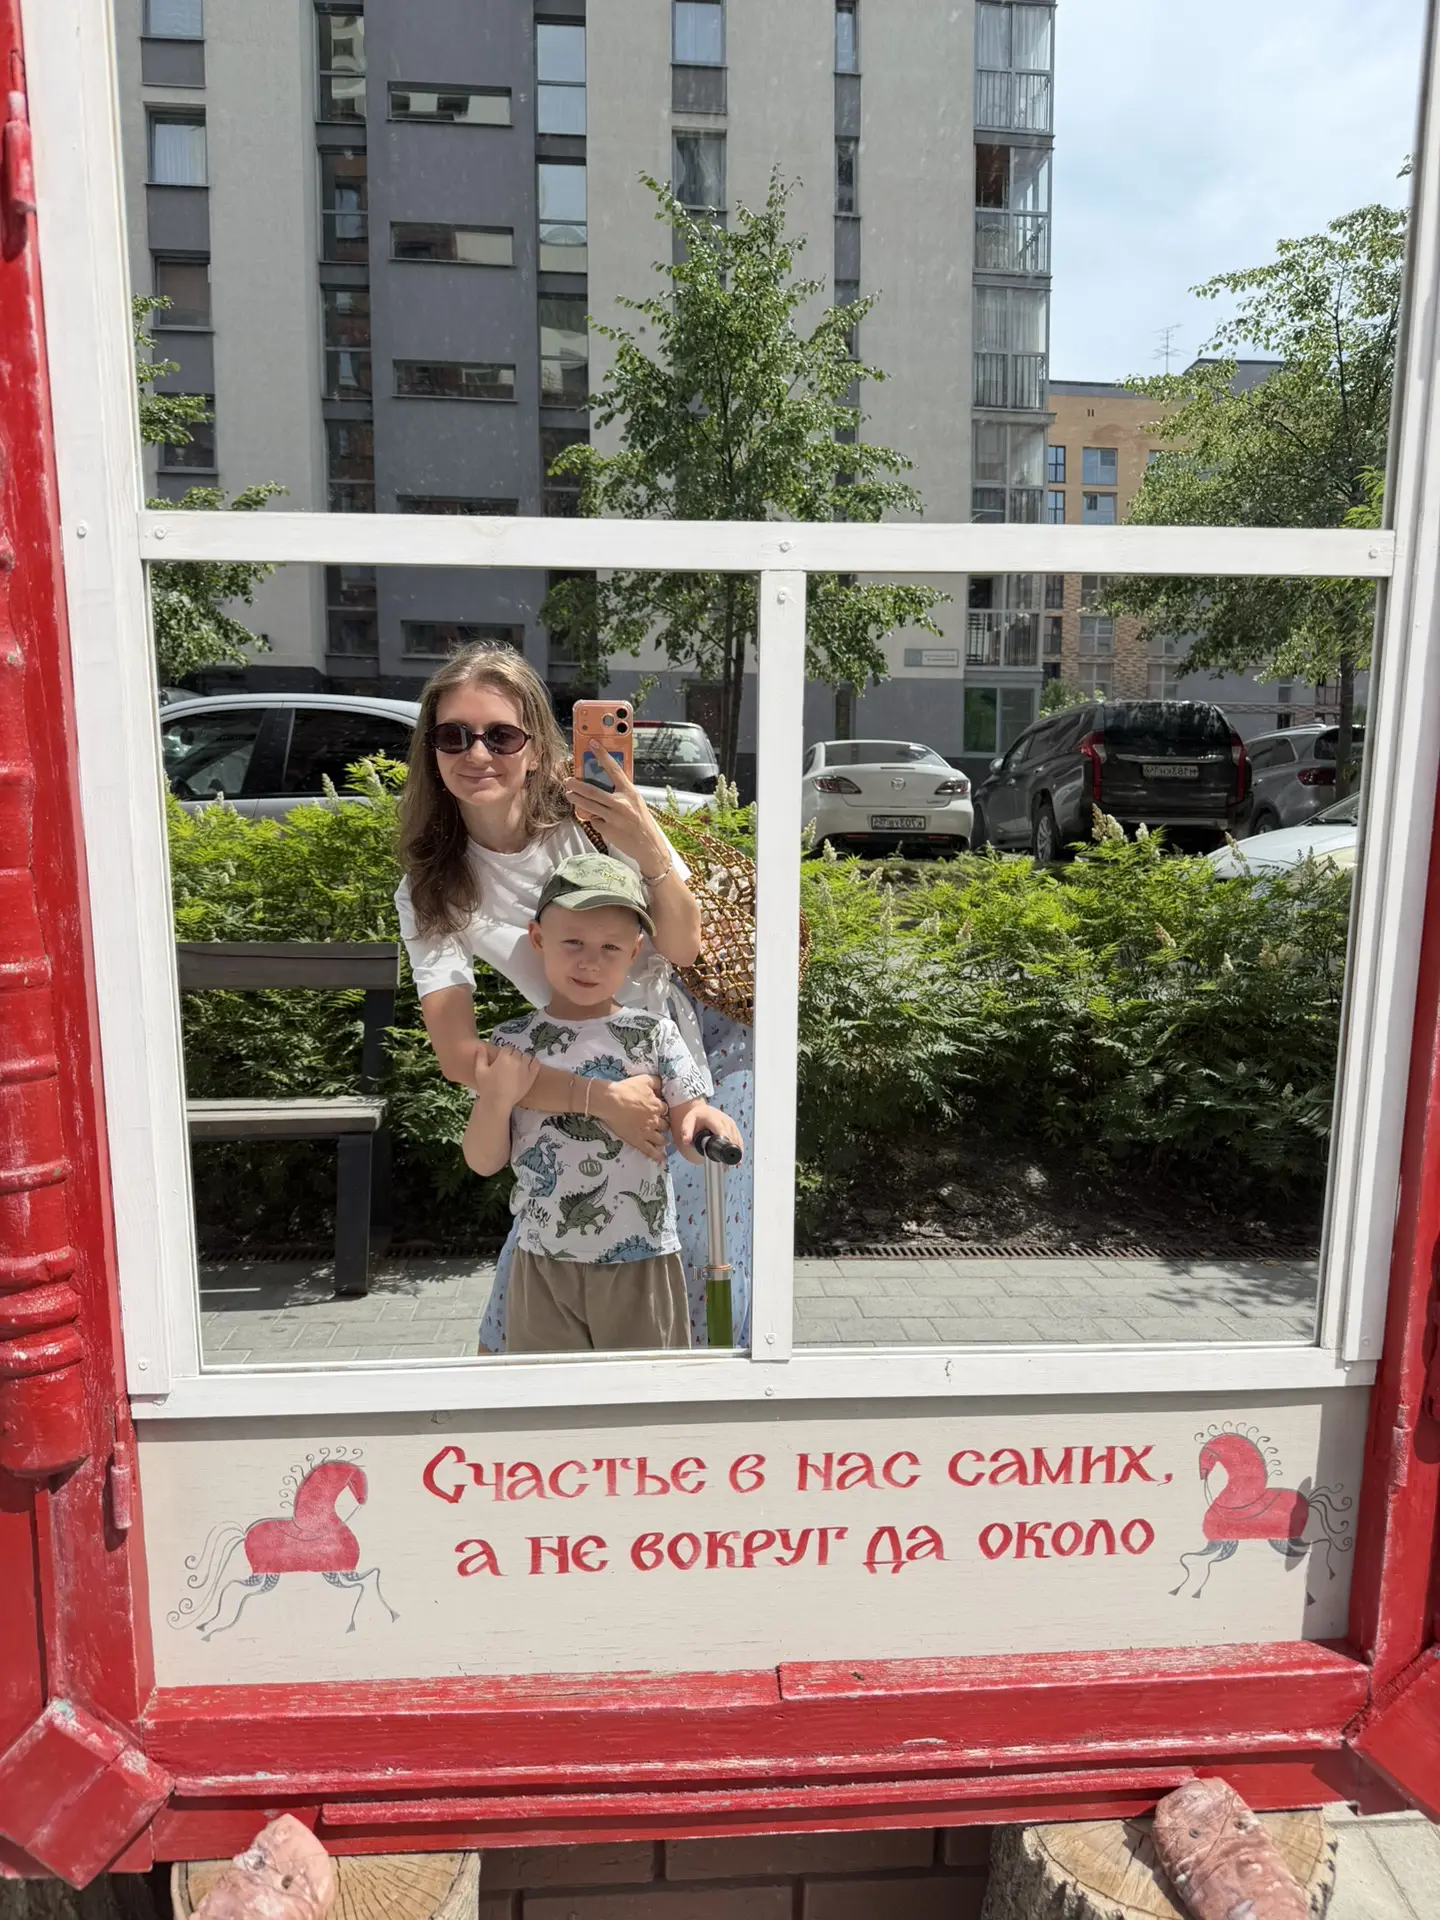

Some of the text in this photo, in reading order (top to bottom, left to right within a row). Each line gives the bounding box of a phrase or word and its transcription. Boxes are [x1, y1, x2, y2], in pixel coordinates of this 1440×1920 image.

[421, 1445, 1174, 1504] Счастье в нас самих,
[454, 1519, 1155, 1578] а не вокруг да около
